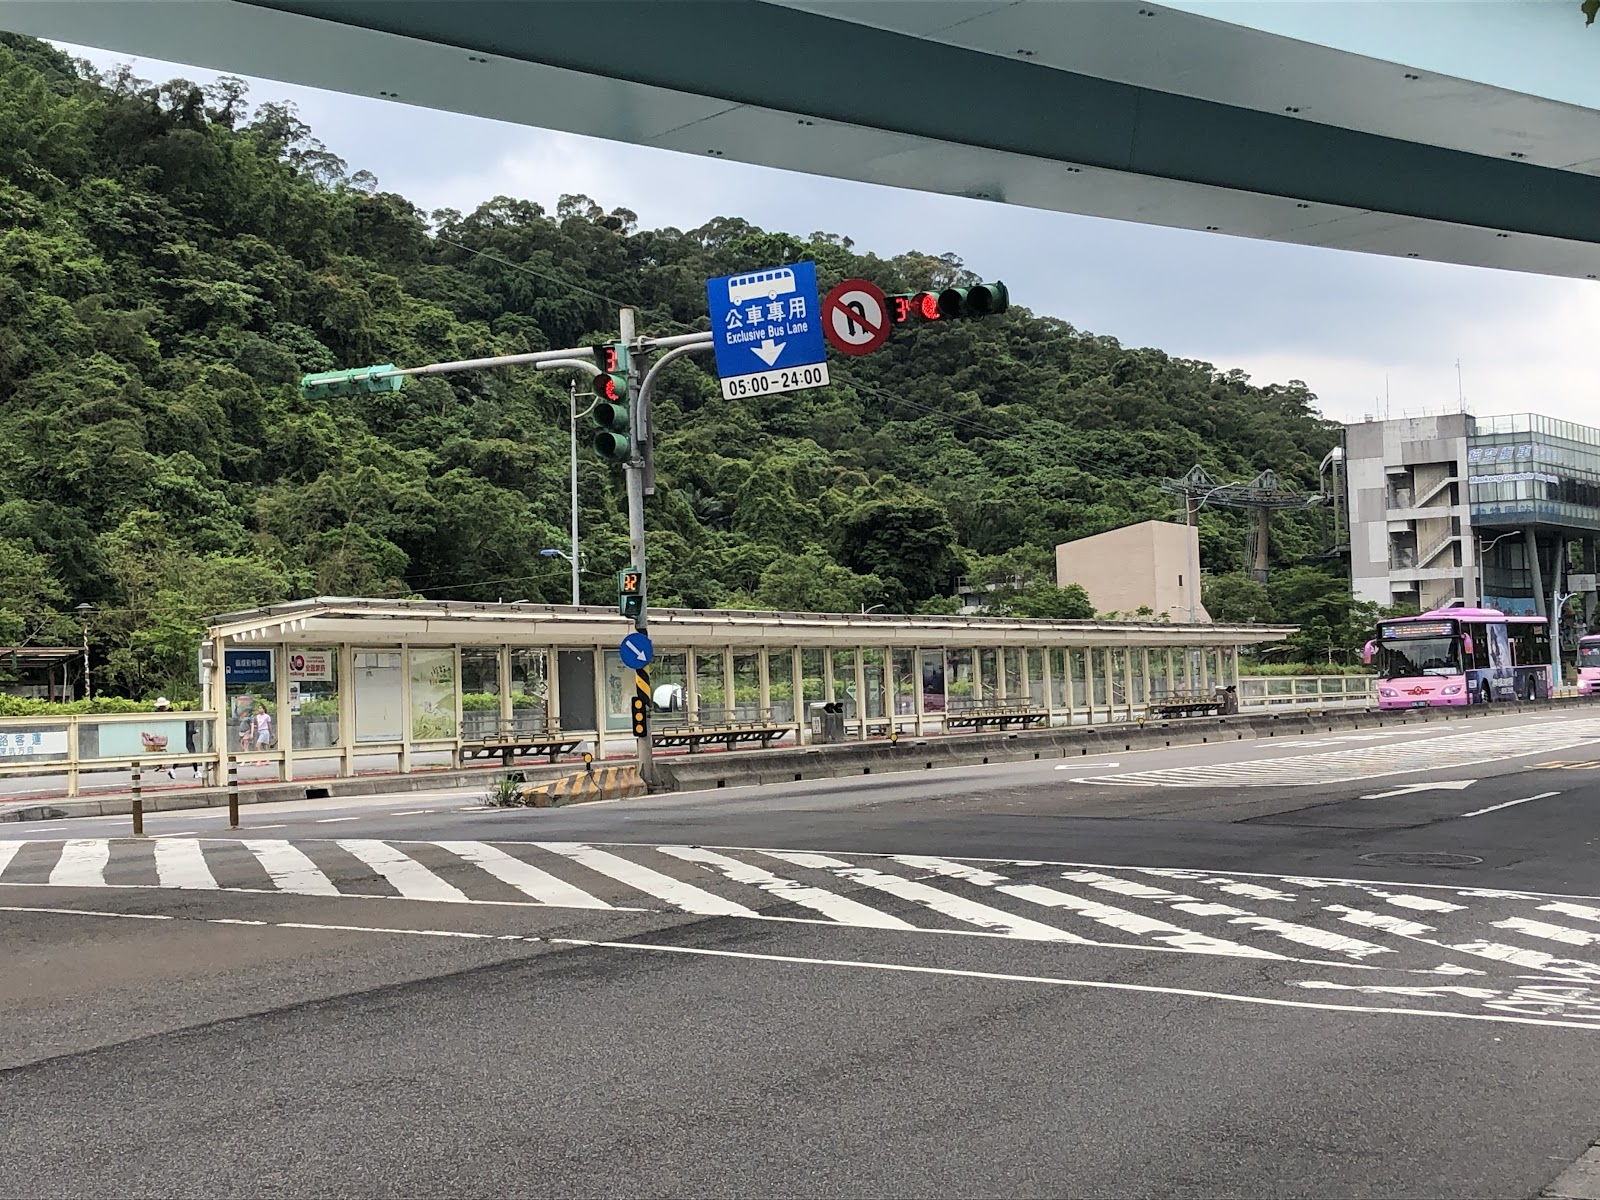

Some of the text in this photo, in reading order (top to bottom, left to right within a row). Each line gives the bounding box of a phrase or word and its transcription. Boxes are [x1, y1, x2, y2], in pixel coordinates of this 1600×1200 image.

[725, 296, 807, 330] 公車專用
[726, 321, 809, 345] Exclusive Bus Lane
[728, 367, 823, 396] 05:00-24:00
